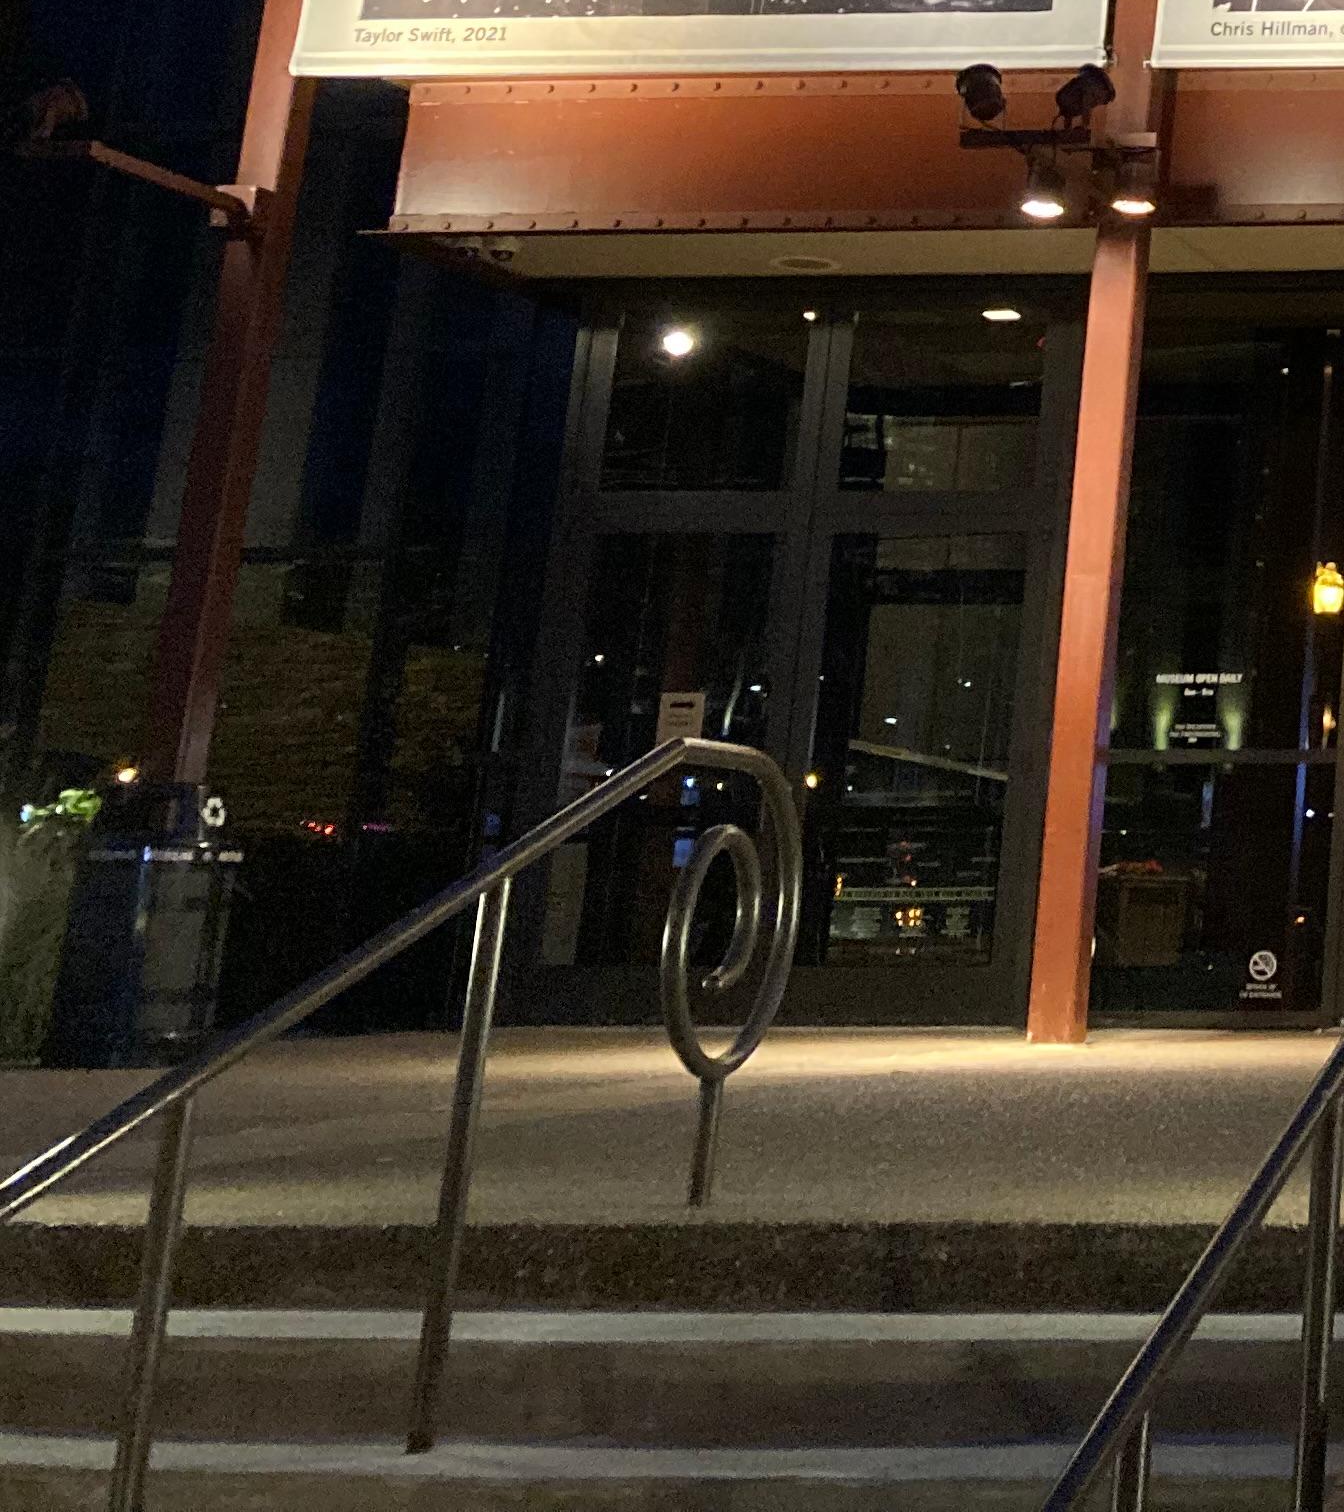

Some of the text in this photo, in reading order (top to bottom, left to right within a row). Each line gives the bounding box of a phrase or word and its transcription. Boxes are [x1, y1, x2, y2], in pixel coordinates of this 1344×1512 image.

[354, 26, 508, 46] Taylor Swift, 2021
[1210, 21, 1254, 37] Chris
[1261, 21, 1334, 37] Hillman,
